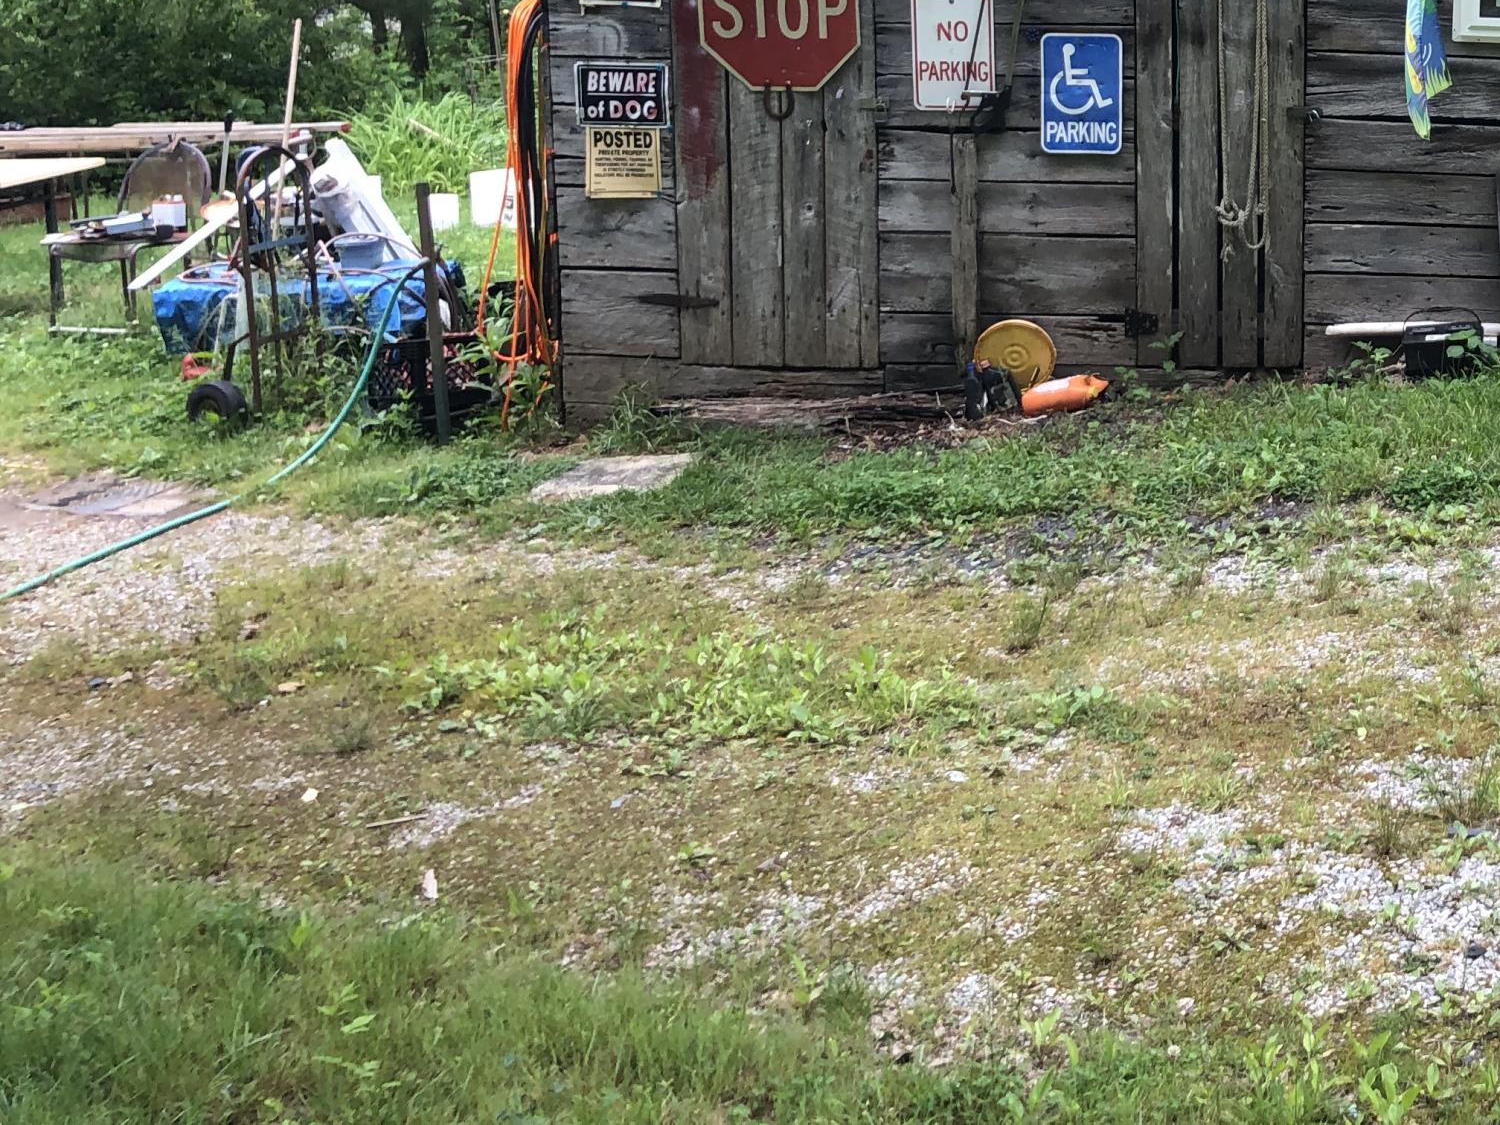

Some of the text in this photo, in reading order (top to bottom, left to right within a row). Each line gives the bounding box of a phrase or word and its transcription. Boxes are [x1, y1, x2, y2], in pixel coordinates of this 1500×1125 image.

[936, 21, 968, 42] NO
[587, 71, 657, 93] BEWARE
[919, 61, 989, 82] PARKING
[587, 100, 658, 120] of DOG
[593, 130, 653, 148] POSTED
[1046, 121, 1117, 144] PARKING
